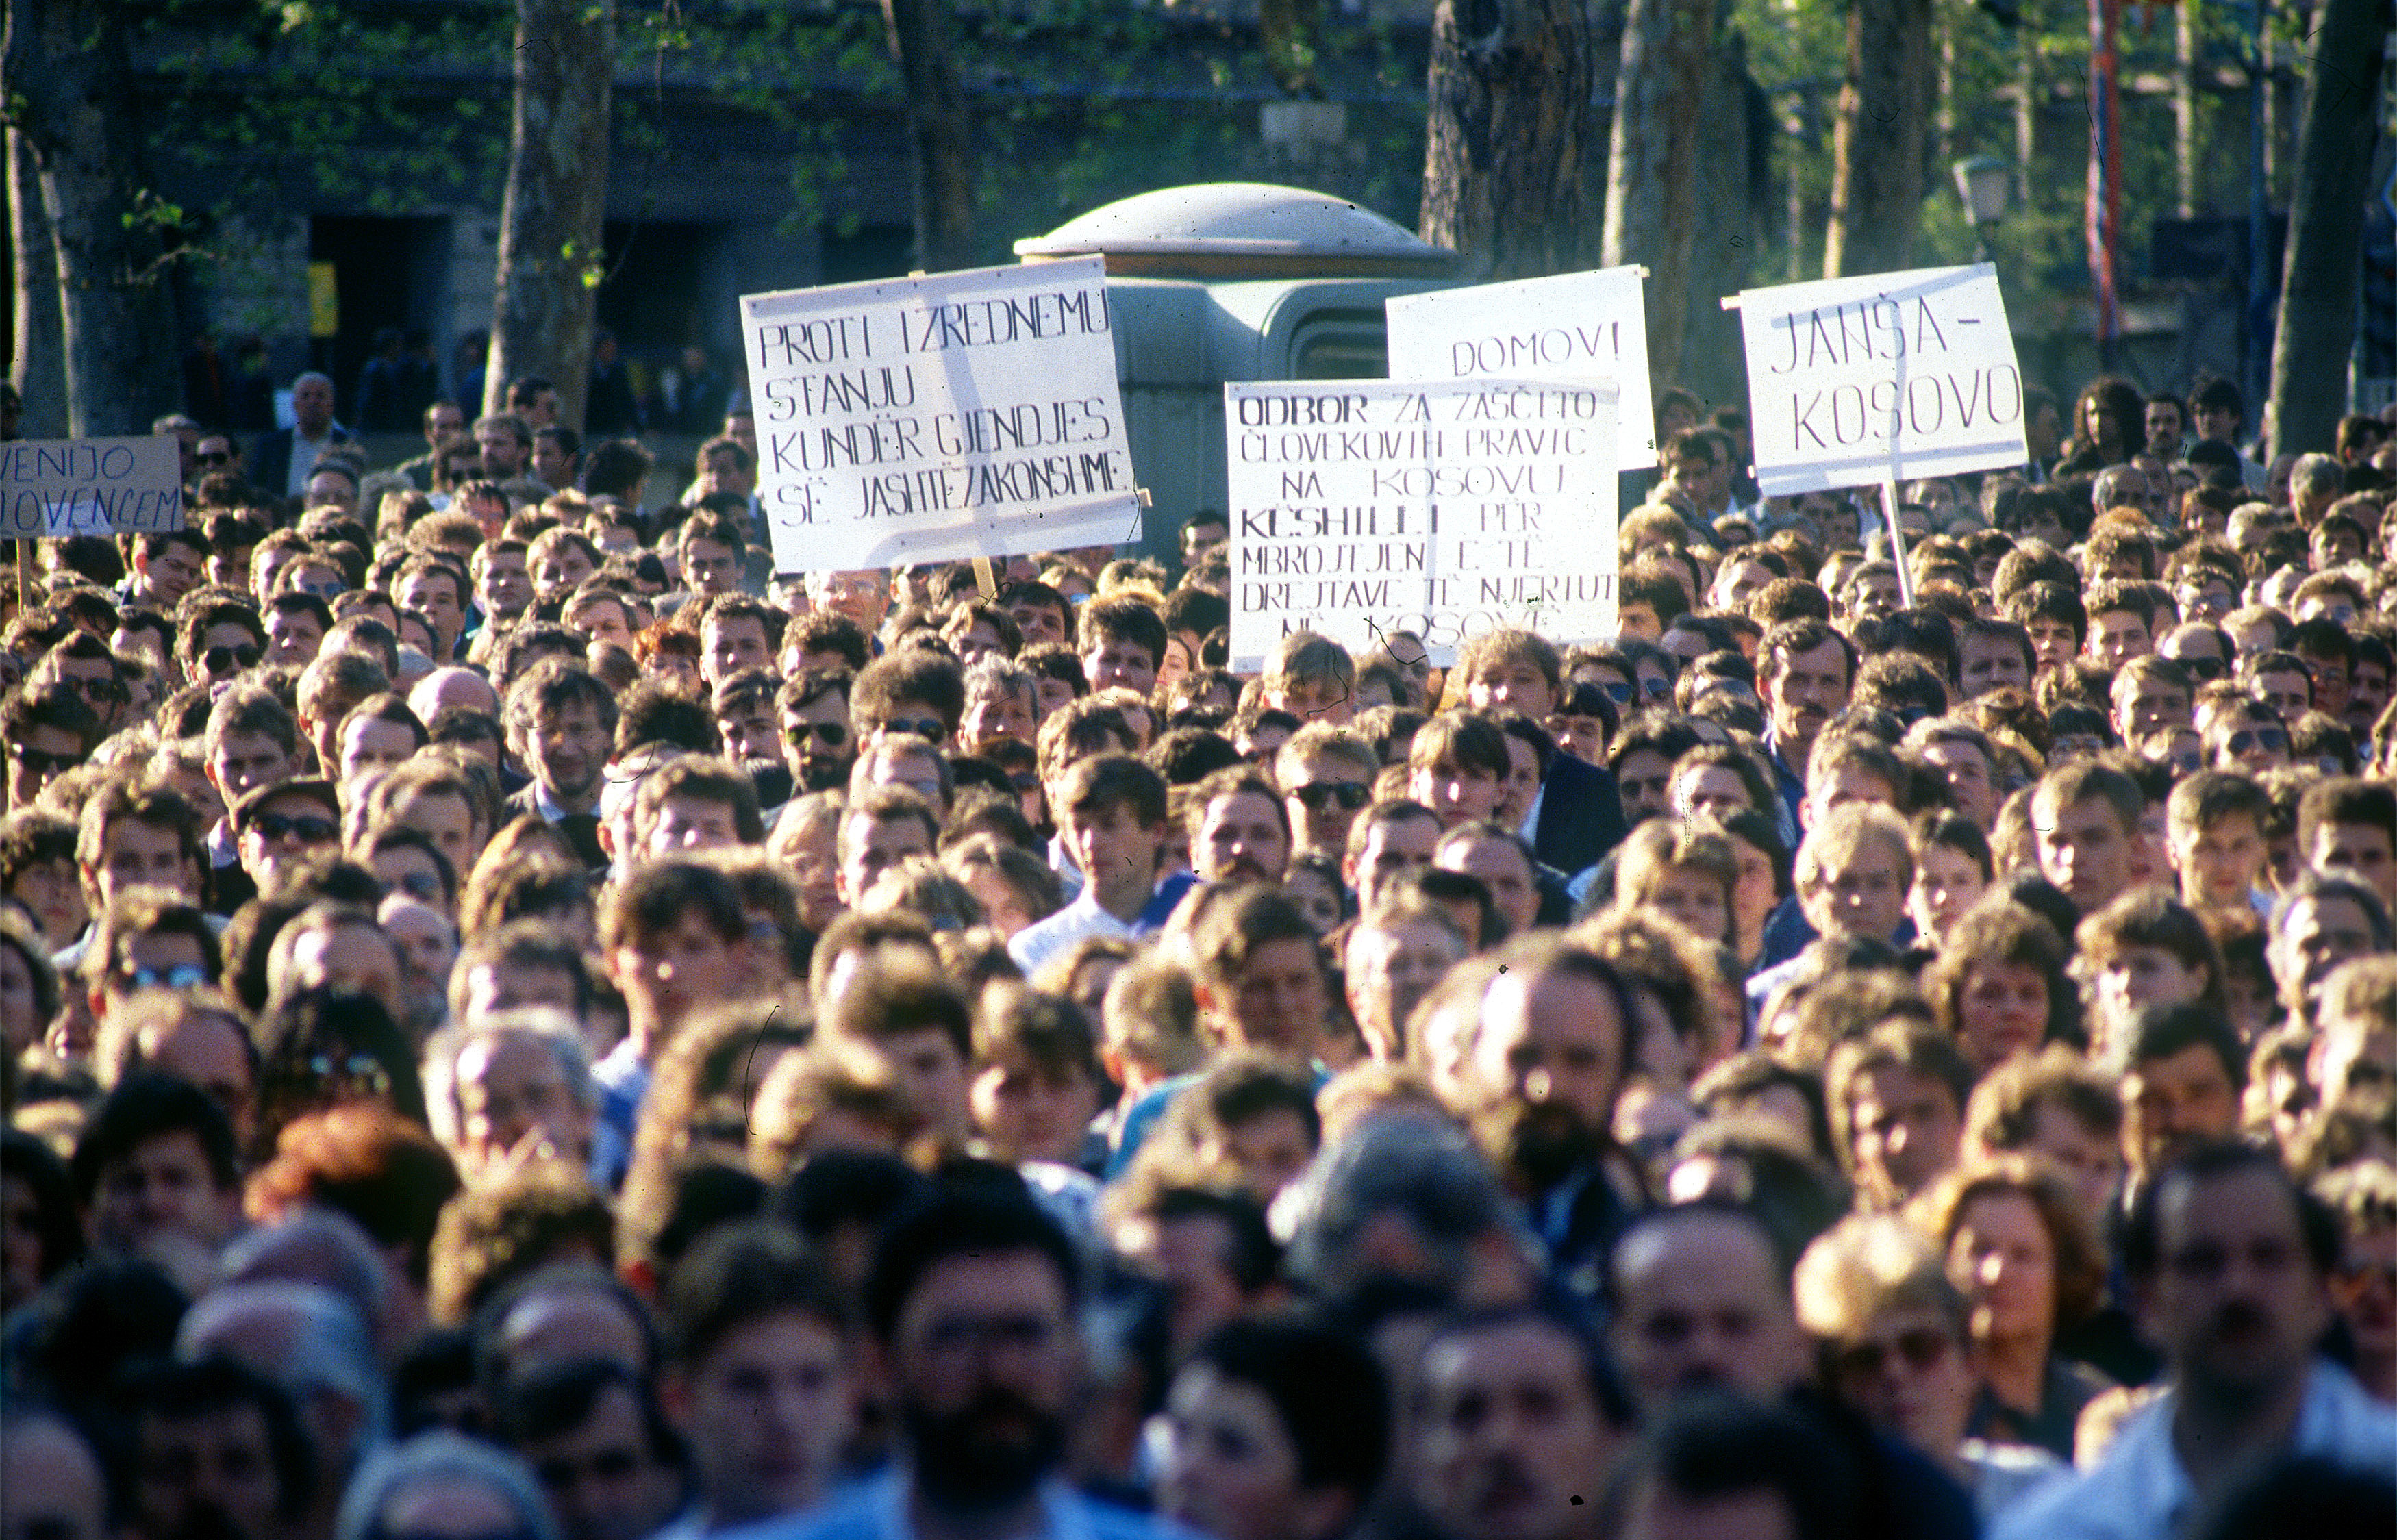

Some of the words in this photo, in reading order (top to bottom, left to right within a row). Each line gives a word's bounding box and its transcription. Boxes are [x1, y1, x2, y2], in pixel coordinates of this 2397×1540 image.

[759, 314, 871, 370] PROTI
[901, 288, 1110, 354] IZREDNEMU
[1452, 321, 1620, 377] DOMOV!
[765, 364, 915, 422] STANJU
[1238, 394, 1368, 426] ODBOR
[1392, 392, 1431, 422] ZA
[1452, 384, 1596, 420] ZAŠČITO
[1793, 364, 2021, 451] KOSOVO
[771, 412, 925, 474] KUNDËR
[933, 396, 1111, 457] GJENDJES
[1240, 428, 1442, 463] ČLOVEKOVIH
[1466, 427, 1586, 457] PRAVIC
[777, 477, 831, 527] SË
[853, 449, 1128, 520] JASHTËZAKONSHME
[1282, 470, 1324, 499] NA
[1372, 464, 1564, 497] KOSOVU
[1241, 503, 1438, 538] KËSHILLI
[1481, 497, 1542, 531] PËR
[1242, 542, 1425, 575] MBROJTJEN
[1459, 540, 1479, 570] E
[1242, 579, 1403, 612] DREJTAVE
[1481, 573, 1620, 603] NJERIUT
